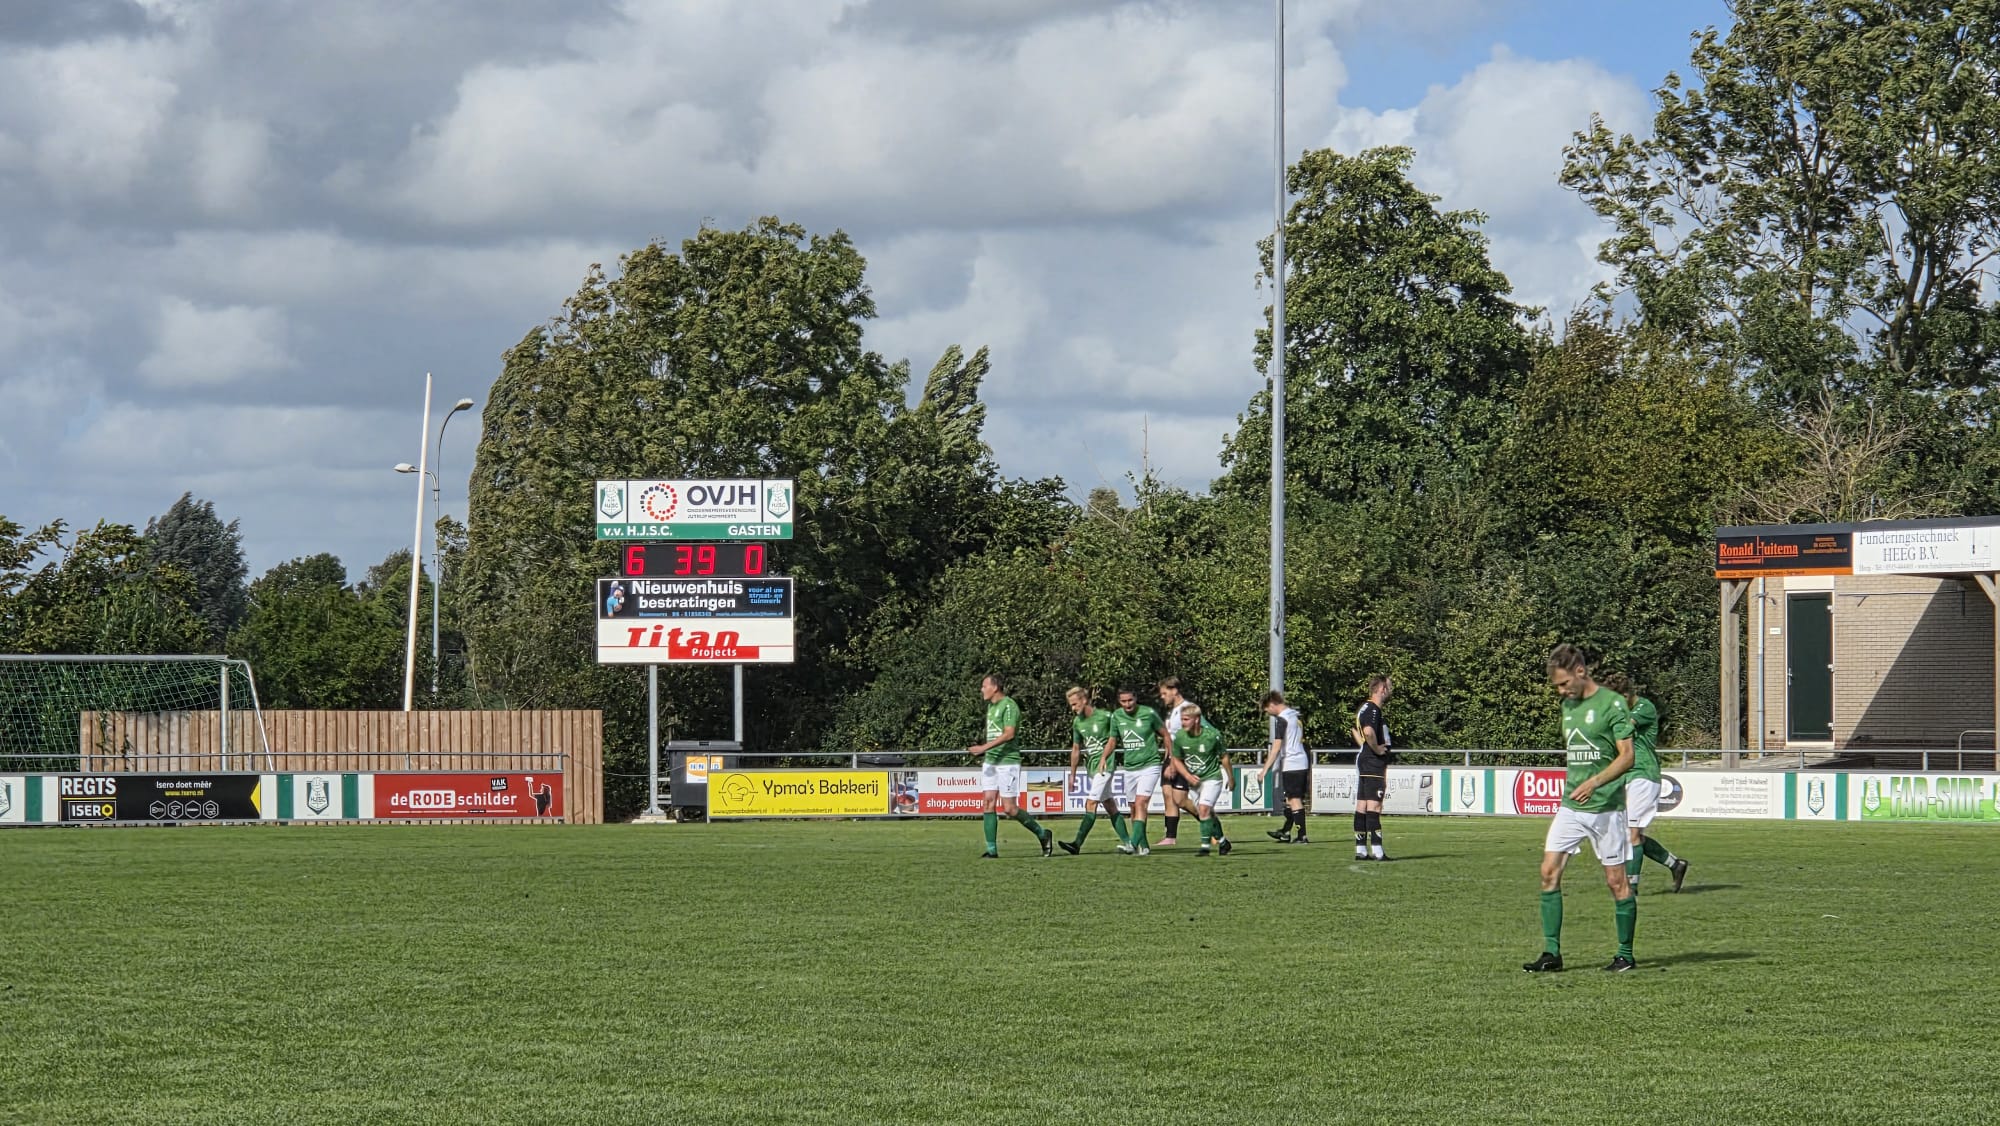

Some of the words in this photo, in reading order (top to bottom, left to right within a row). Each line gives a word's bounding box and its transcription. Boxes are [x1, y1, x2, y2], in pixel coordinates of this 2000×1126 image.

[686, 485, 756, 506] OVJH
[603, 527, 624, 536] v.v.
[627, 525, 673, 536] H.J.S.C.
[728, 525, 781, 536] GASTEN
[1859, 528, 1960, 547] Funderingstechniek
[1719, 542, 1754, 557] Ronald
[1756, 536, 1799, 558] Huitema
[1883, 547, 1916, 562] HEEG
[1919, 546, 1939, 561] B.V.
[626, 546, 645, 575] 6
[674, 545, 716, 575] 39
[744, 545, 763, 575] 0
[631, 580, 743, 595] Nieuwenhuis
[639, 595, 736, 611] bestratingen
[627, 624, 740, 648] Titan
[691, 648, 737, 659] Projects
[61, 778, 117, 796] REGTS
[156, 780, 175, 789] Isero
[175, 780, 193, 789] doet
[491, 778, 507, 786] VAK
[762, 779, 815, 798] Ypma's
[819, 779, 880, 797] Bakkerij
[937, 776, 977, 787] Drukwerk
[391, 793, 408, 806] de
[412, 793, 452, 806] RODE
[457, 792, 518, 806] schilder
[1031, 796, 1041, 808] G
[1890, 776, 1985, 820] FAR-SIDE
[71, 803, 113, 817] ISERO
[1524, 802, 1551, 813] Horeca
